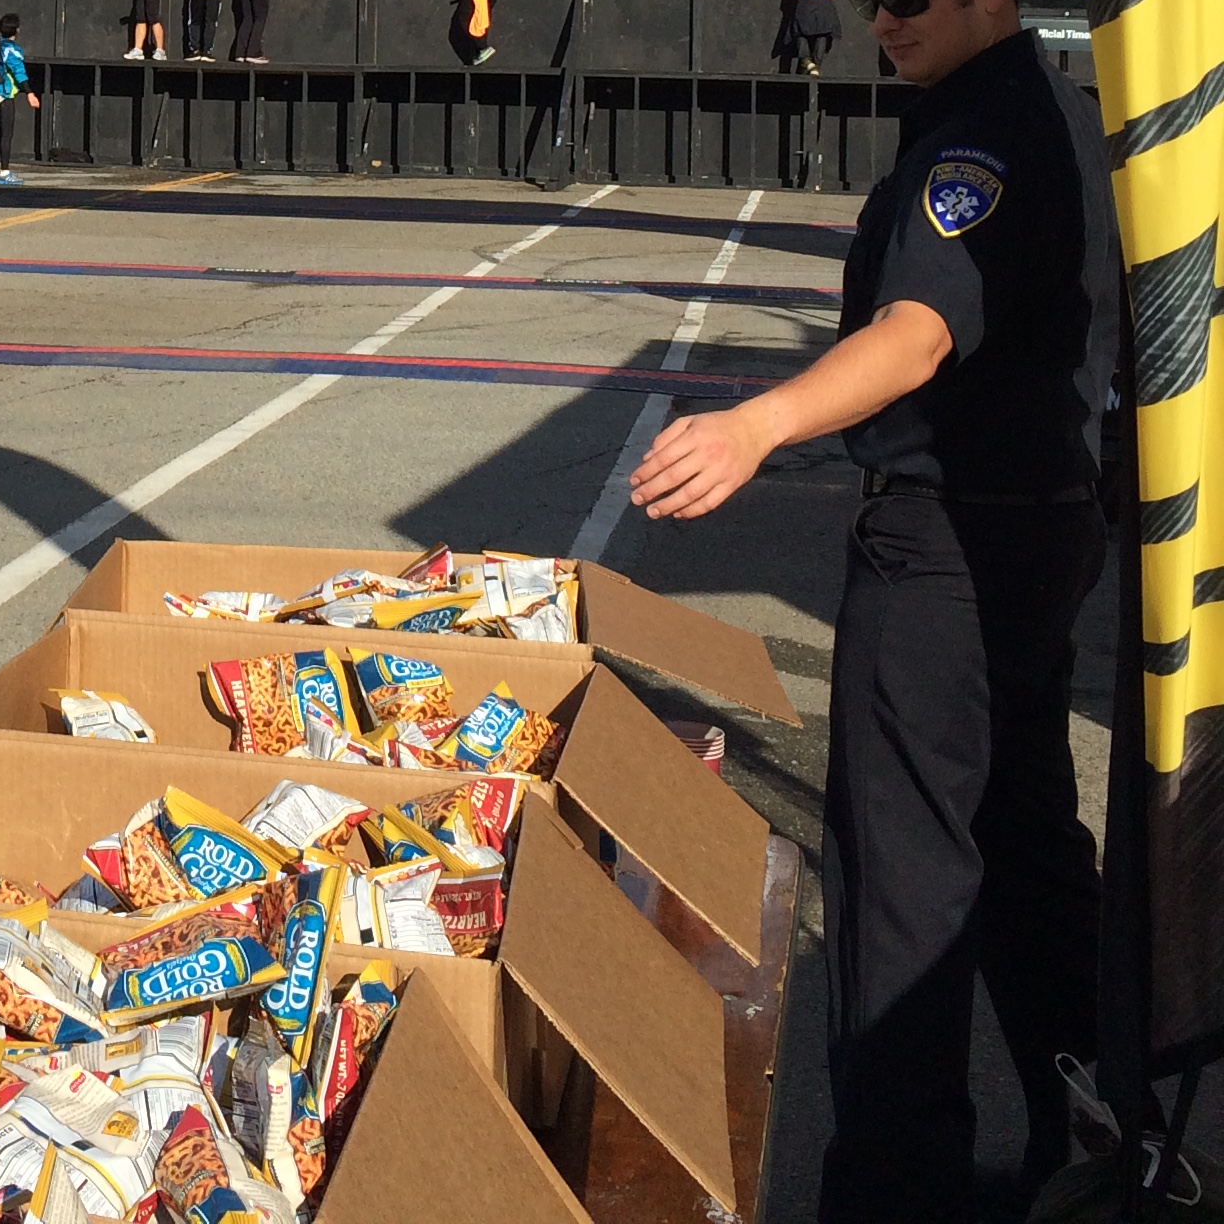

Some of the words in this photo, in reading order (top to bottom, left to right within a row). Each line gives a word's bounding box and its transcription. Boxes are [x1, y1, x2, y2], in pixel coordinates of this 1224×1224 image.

[941, 149, 1005, 173] PARAMEDIC
[196, 834, 254, 880] ROLD
[143, 949, 227, 999] GOLD
[289, 927, 320, 1011] ROLD
